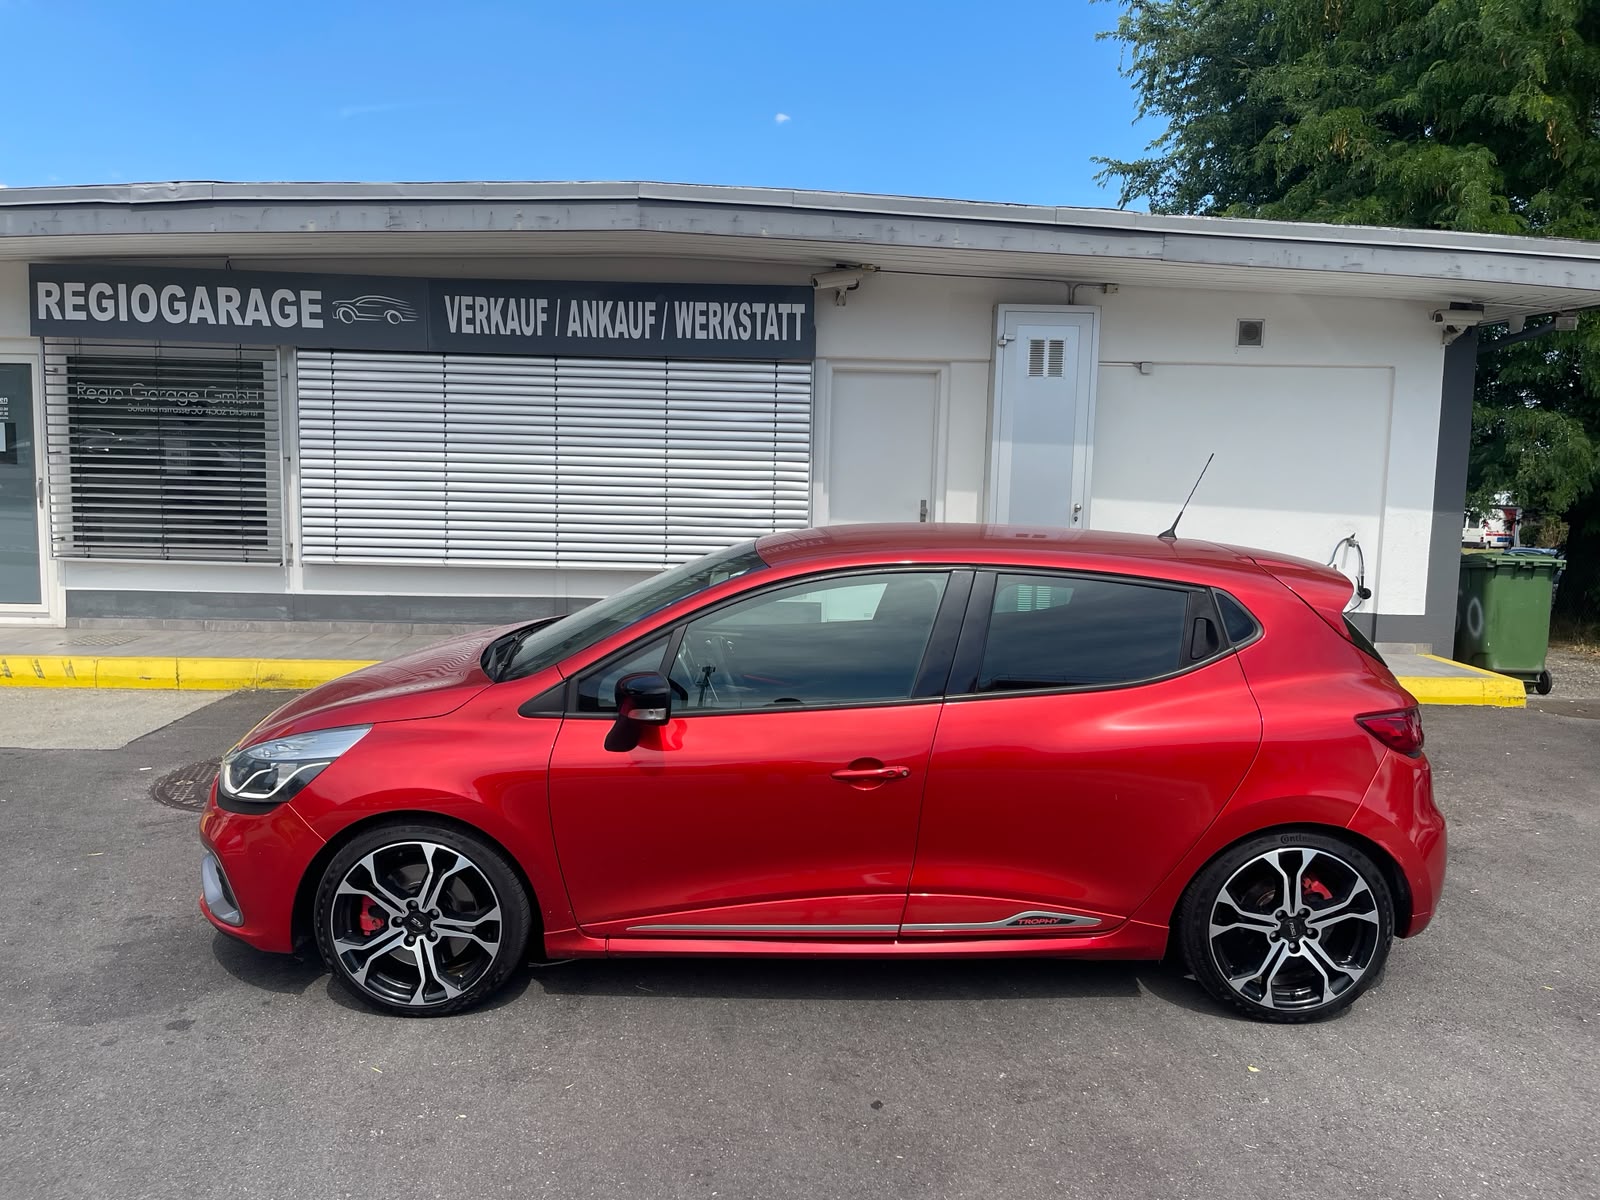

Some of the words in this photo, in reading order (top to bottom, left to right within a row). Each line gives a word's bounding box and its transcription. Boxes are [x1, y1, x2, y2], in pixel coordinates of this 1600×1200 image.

[37, 281, 324, 329] REGIOGARAGE
[444, 295, 549, 336] VERKAUF
[555, 298, 561, 337] /
[566, 299, 657, 340] ANKAUF
[661, 301, 669, 340] /
[674, 301, 806, 341] WERKSTATT
[76, 381, 124, 404] Regio
[129, 382, 200, 406] Garage
[204, 385, 259, 405] GmbH
